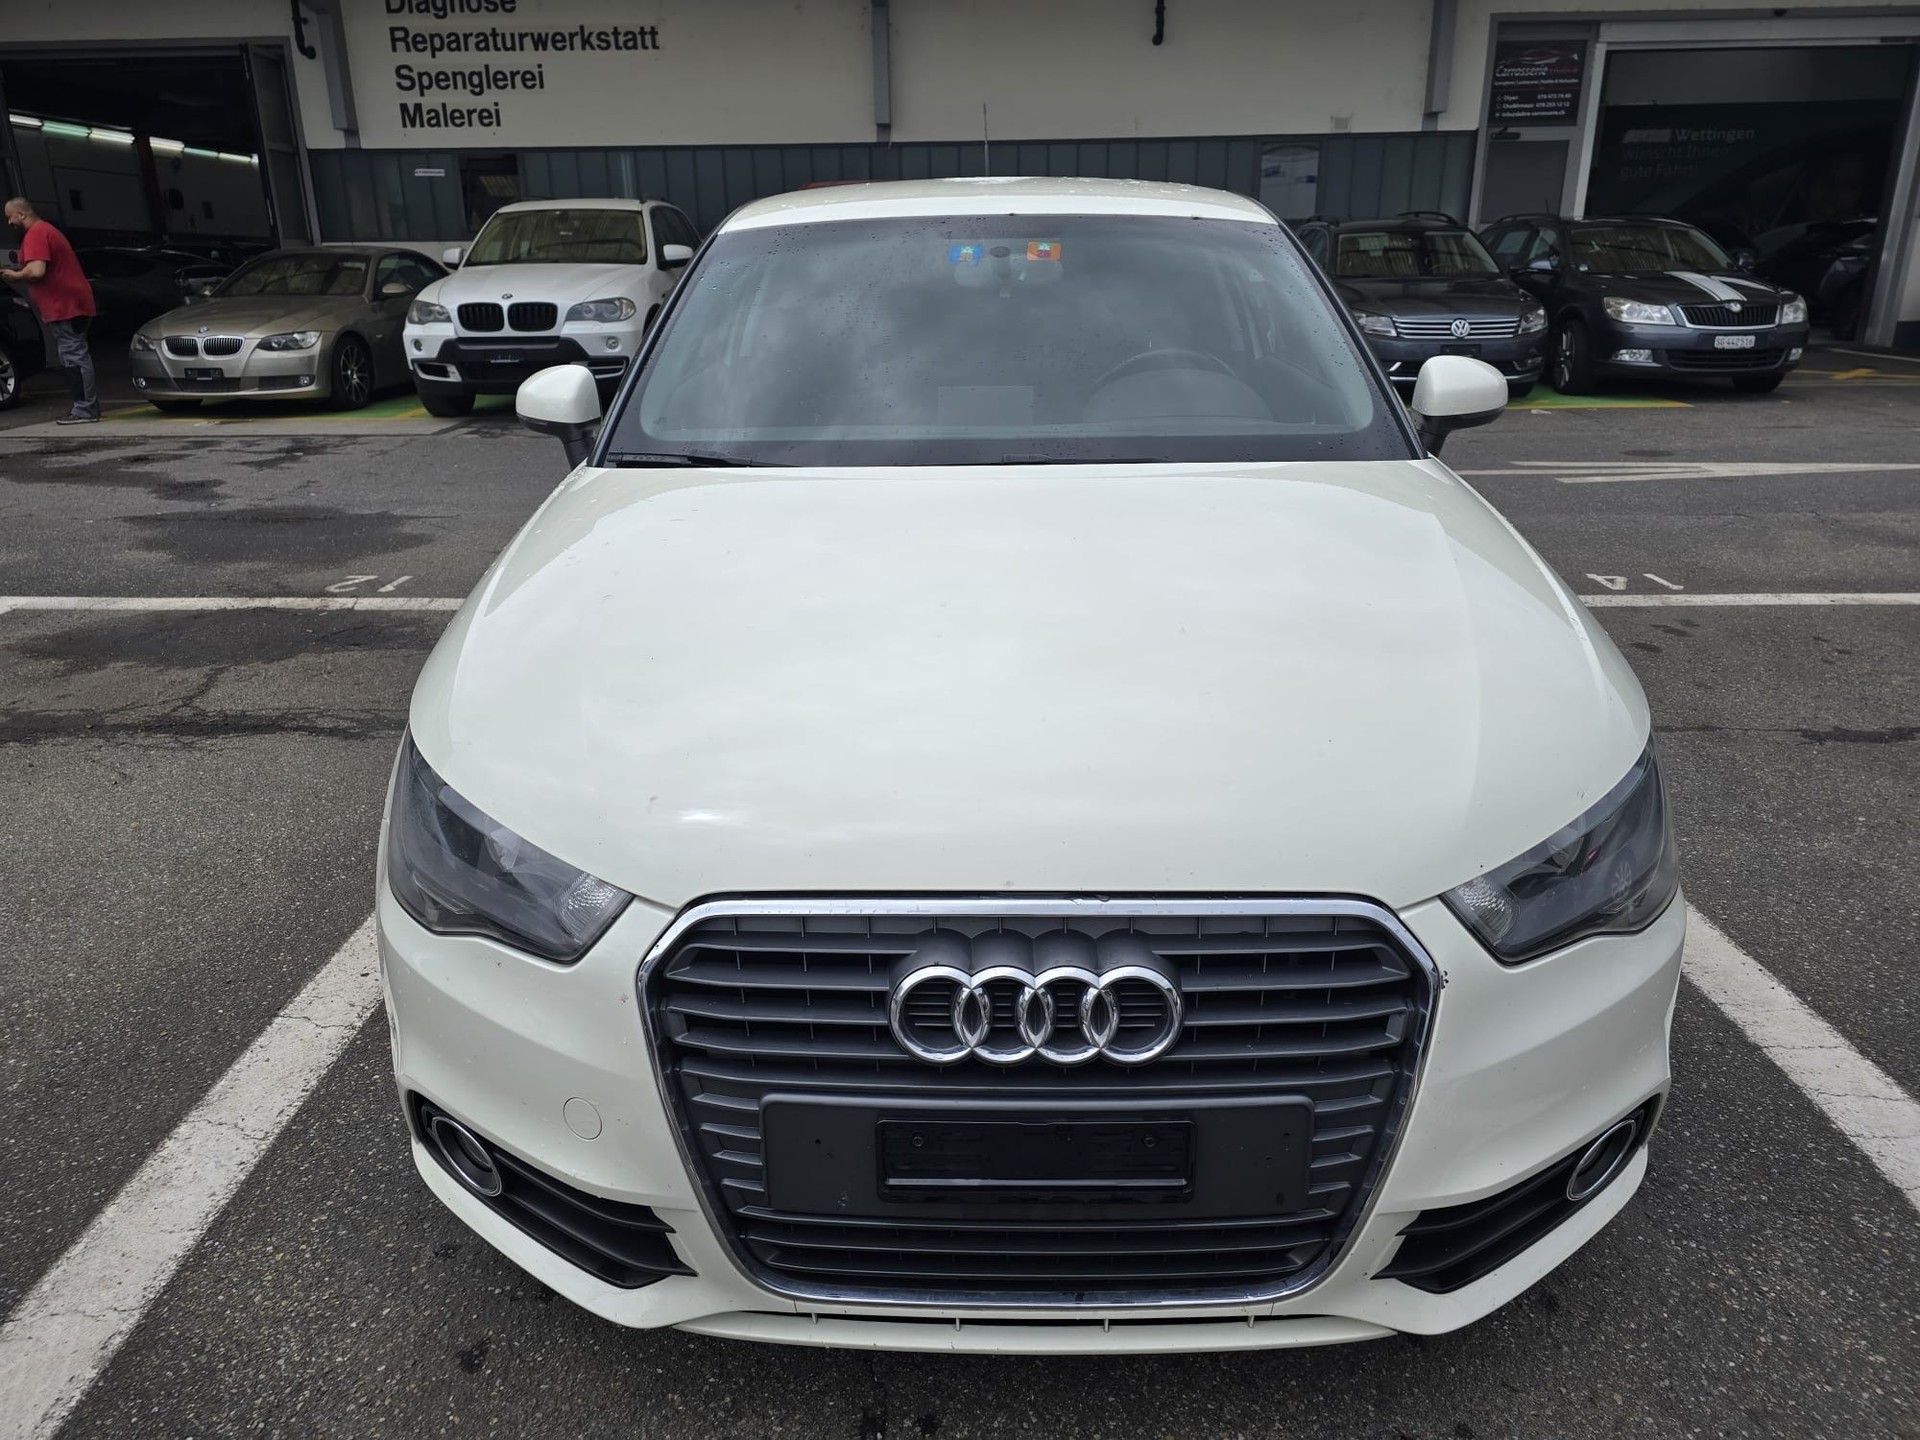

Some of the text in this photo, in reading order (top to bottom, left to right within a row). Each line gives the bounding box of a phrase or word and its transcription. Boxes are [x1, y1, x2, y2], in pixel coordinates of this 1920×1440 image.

[389, 25, 660, 58] Reparaturwerkstatt
[395, 64, 545, 96] Spenglerei
[399, 103, 502, 128] Malerei
[1675, 128, 1755, 144] Wettingen
[325, 575, 414, 592] 12
